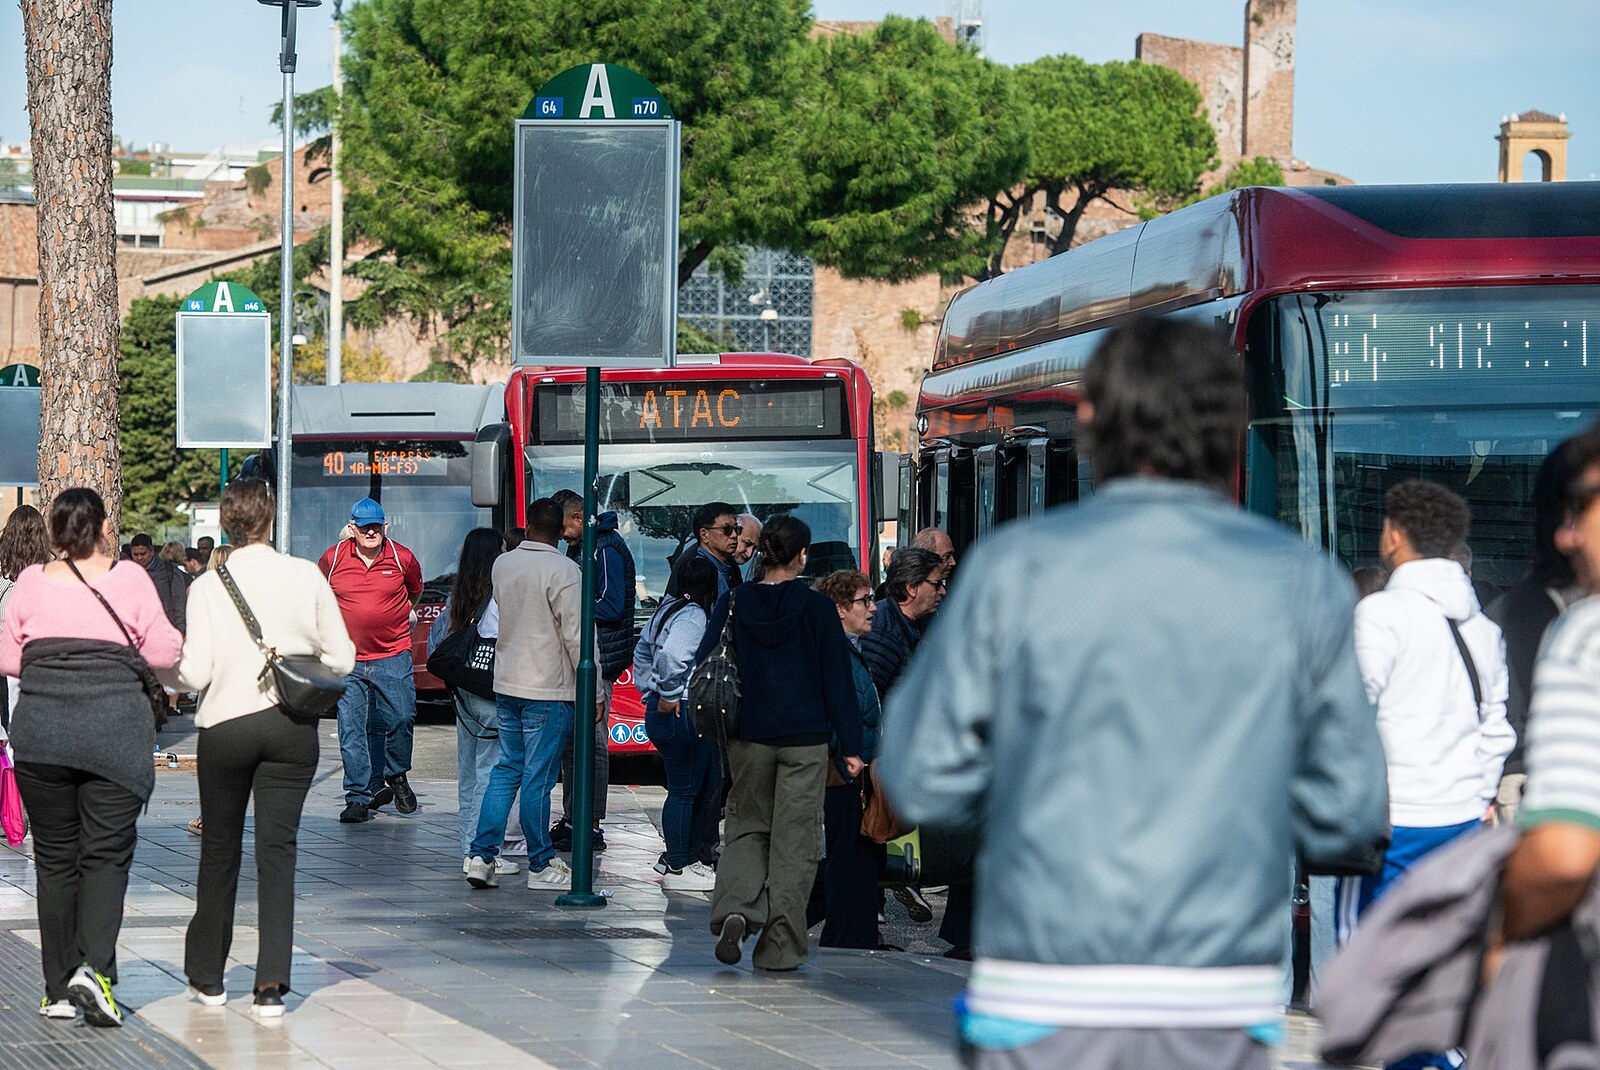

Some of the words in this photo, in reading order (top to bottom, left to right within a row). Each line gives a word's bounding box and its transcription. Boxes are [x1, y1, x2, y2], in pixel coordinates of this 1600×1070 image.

[579, 63, 616, 119] A
[541, 100, 558, 114] 64
[634, 100, 658, 115] n70
[212, 281, 235, 313] A
[12, 364, 29, 387] A
[639, 388, 741, 429] ATAC
[323, 451, 345, 475] 40
[373, 450, 431, 462] EXPRESS
